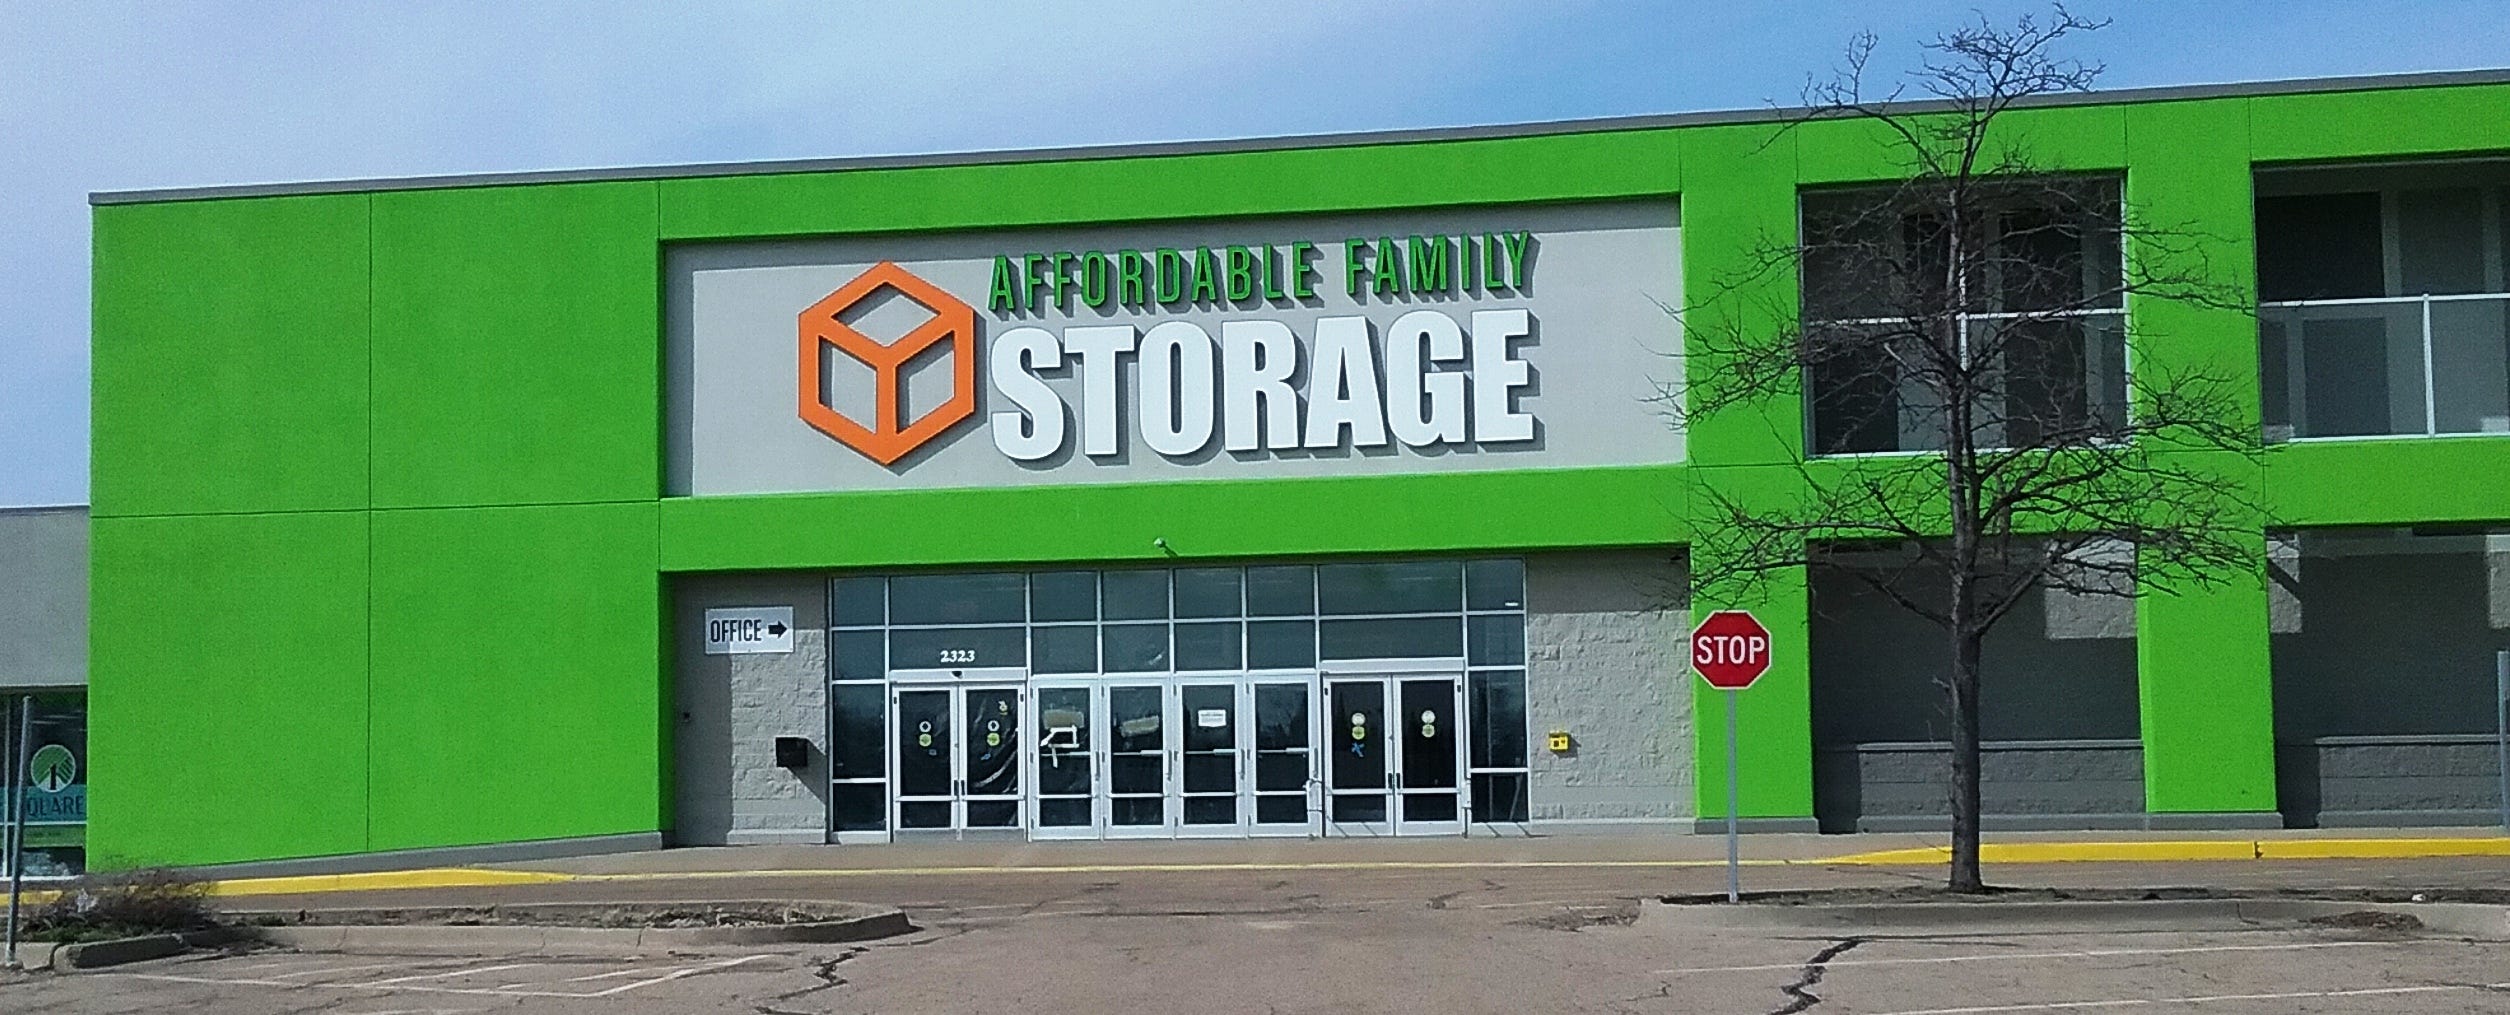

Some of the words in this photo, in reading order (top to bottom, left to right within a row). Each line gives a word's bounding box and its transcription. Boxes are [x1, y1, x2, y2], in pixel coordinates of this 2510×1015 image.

[989, 240, 1313, 311] AFFORDABLE
[1345, 230, 1533, 295] FAMILY
[990, 309, 1534, 461] STORAGE
[710, 619, 762, 643] OFFICE
[940, 650, 975, 663] 2323
[1696, 635, 1765, 665] STOP
